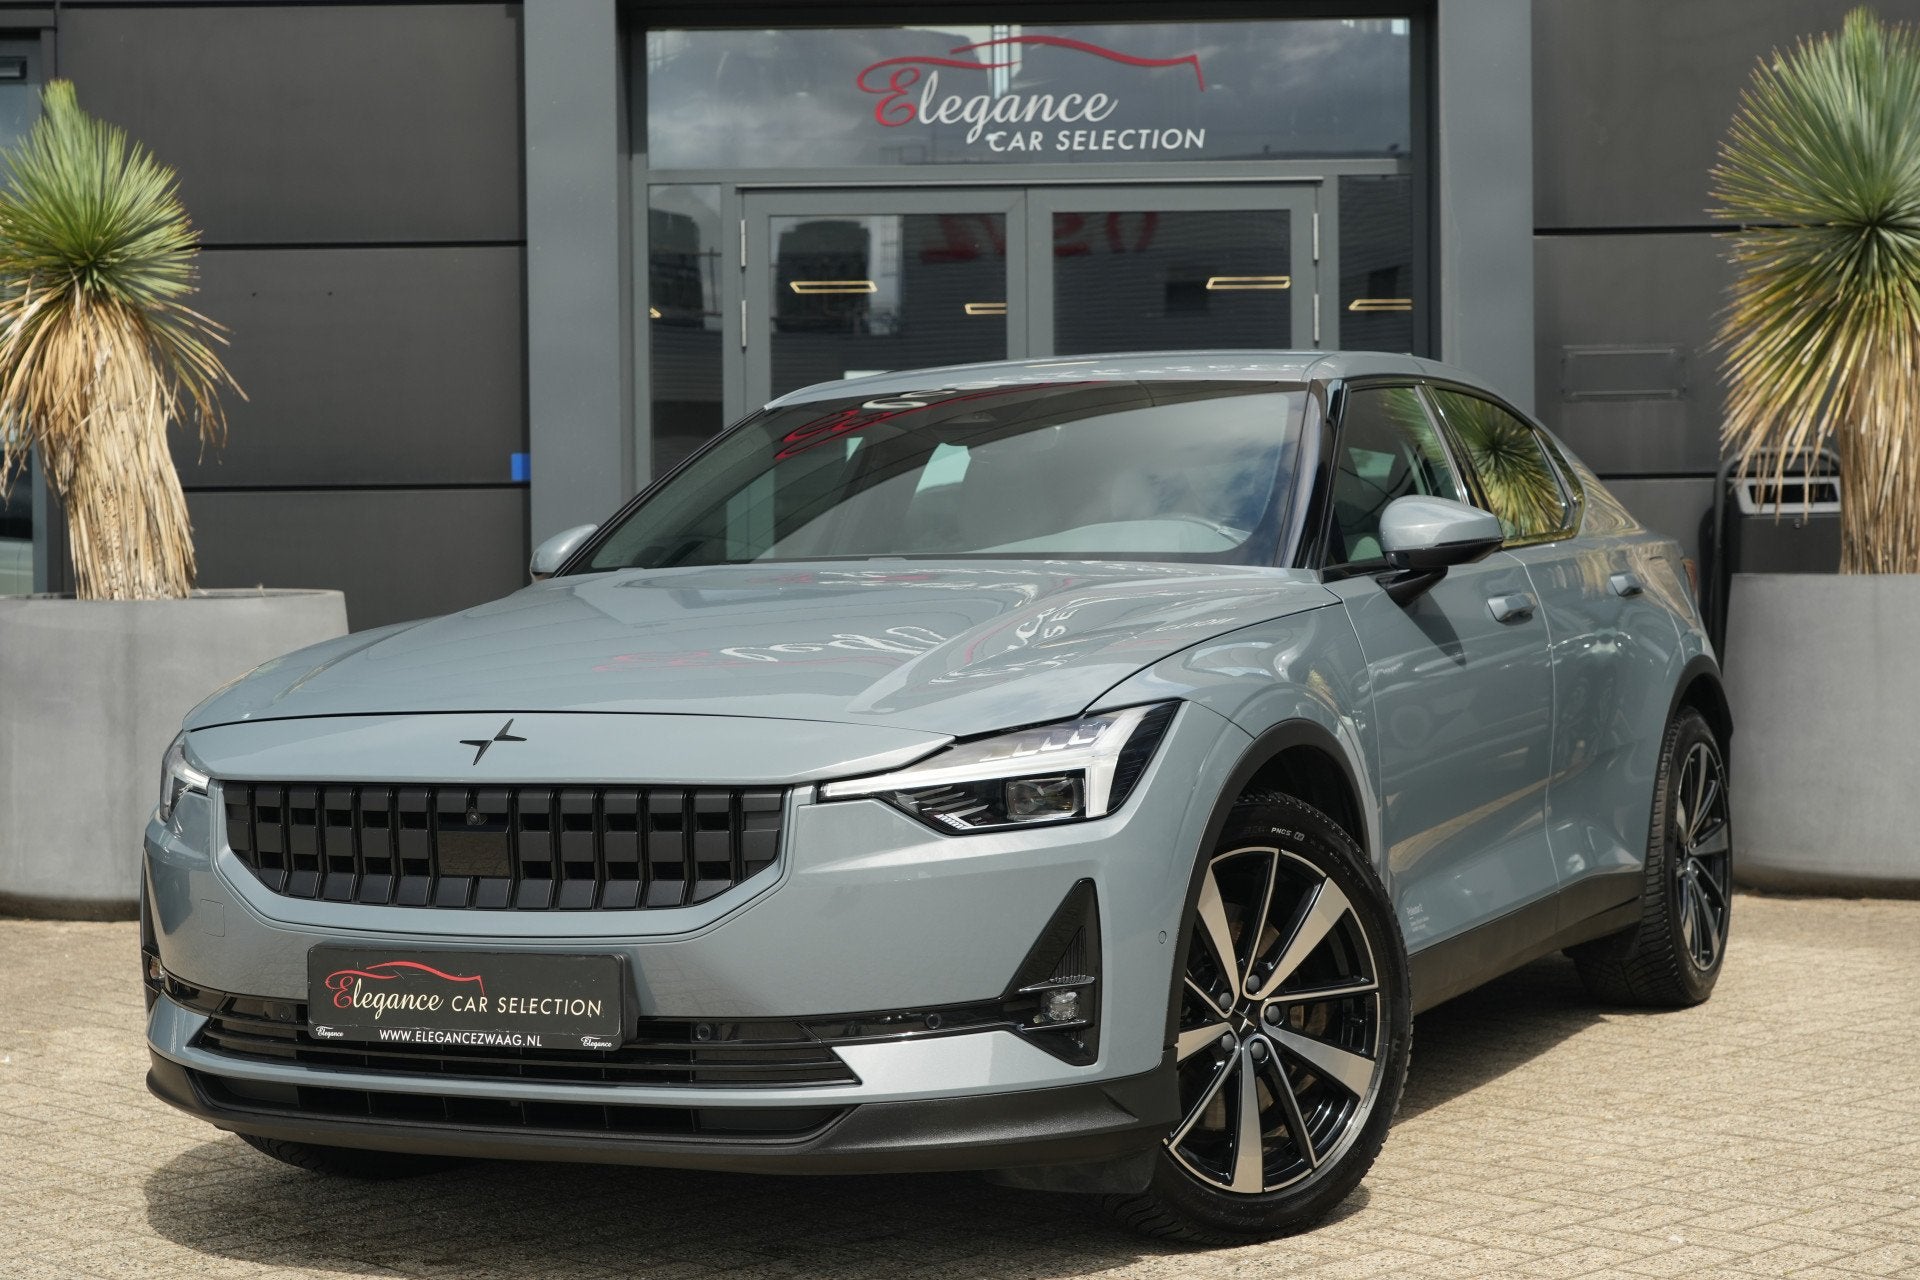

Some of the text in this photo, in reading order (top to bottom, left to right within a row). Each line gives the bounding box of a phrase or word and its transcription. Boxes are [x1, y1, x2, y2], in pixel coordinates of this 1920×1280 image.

[857, 56, 1118, 144] Elegance
[988, 128, 1206, 152] CAR SELECTION
[325, 970, 601, 1020] Elegance CAR SELECTION
[380, 1029, 542, 1047] WWW.ELEGANCEZWAAG.NL
